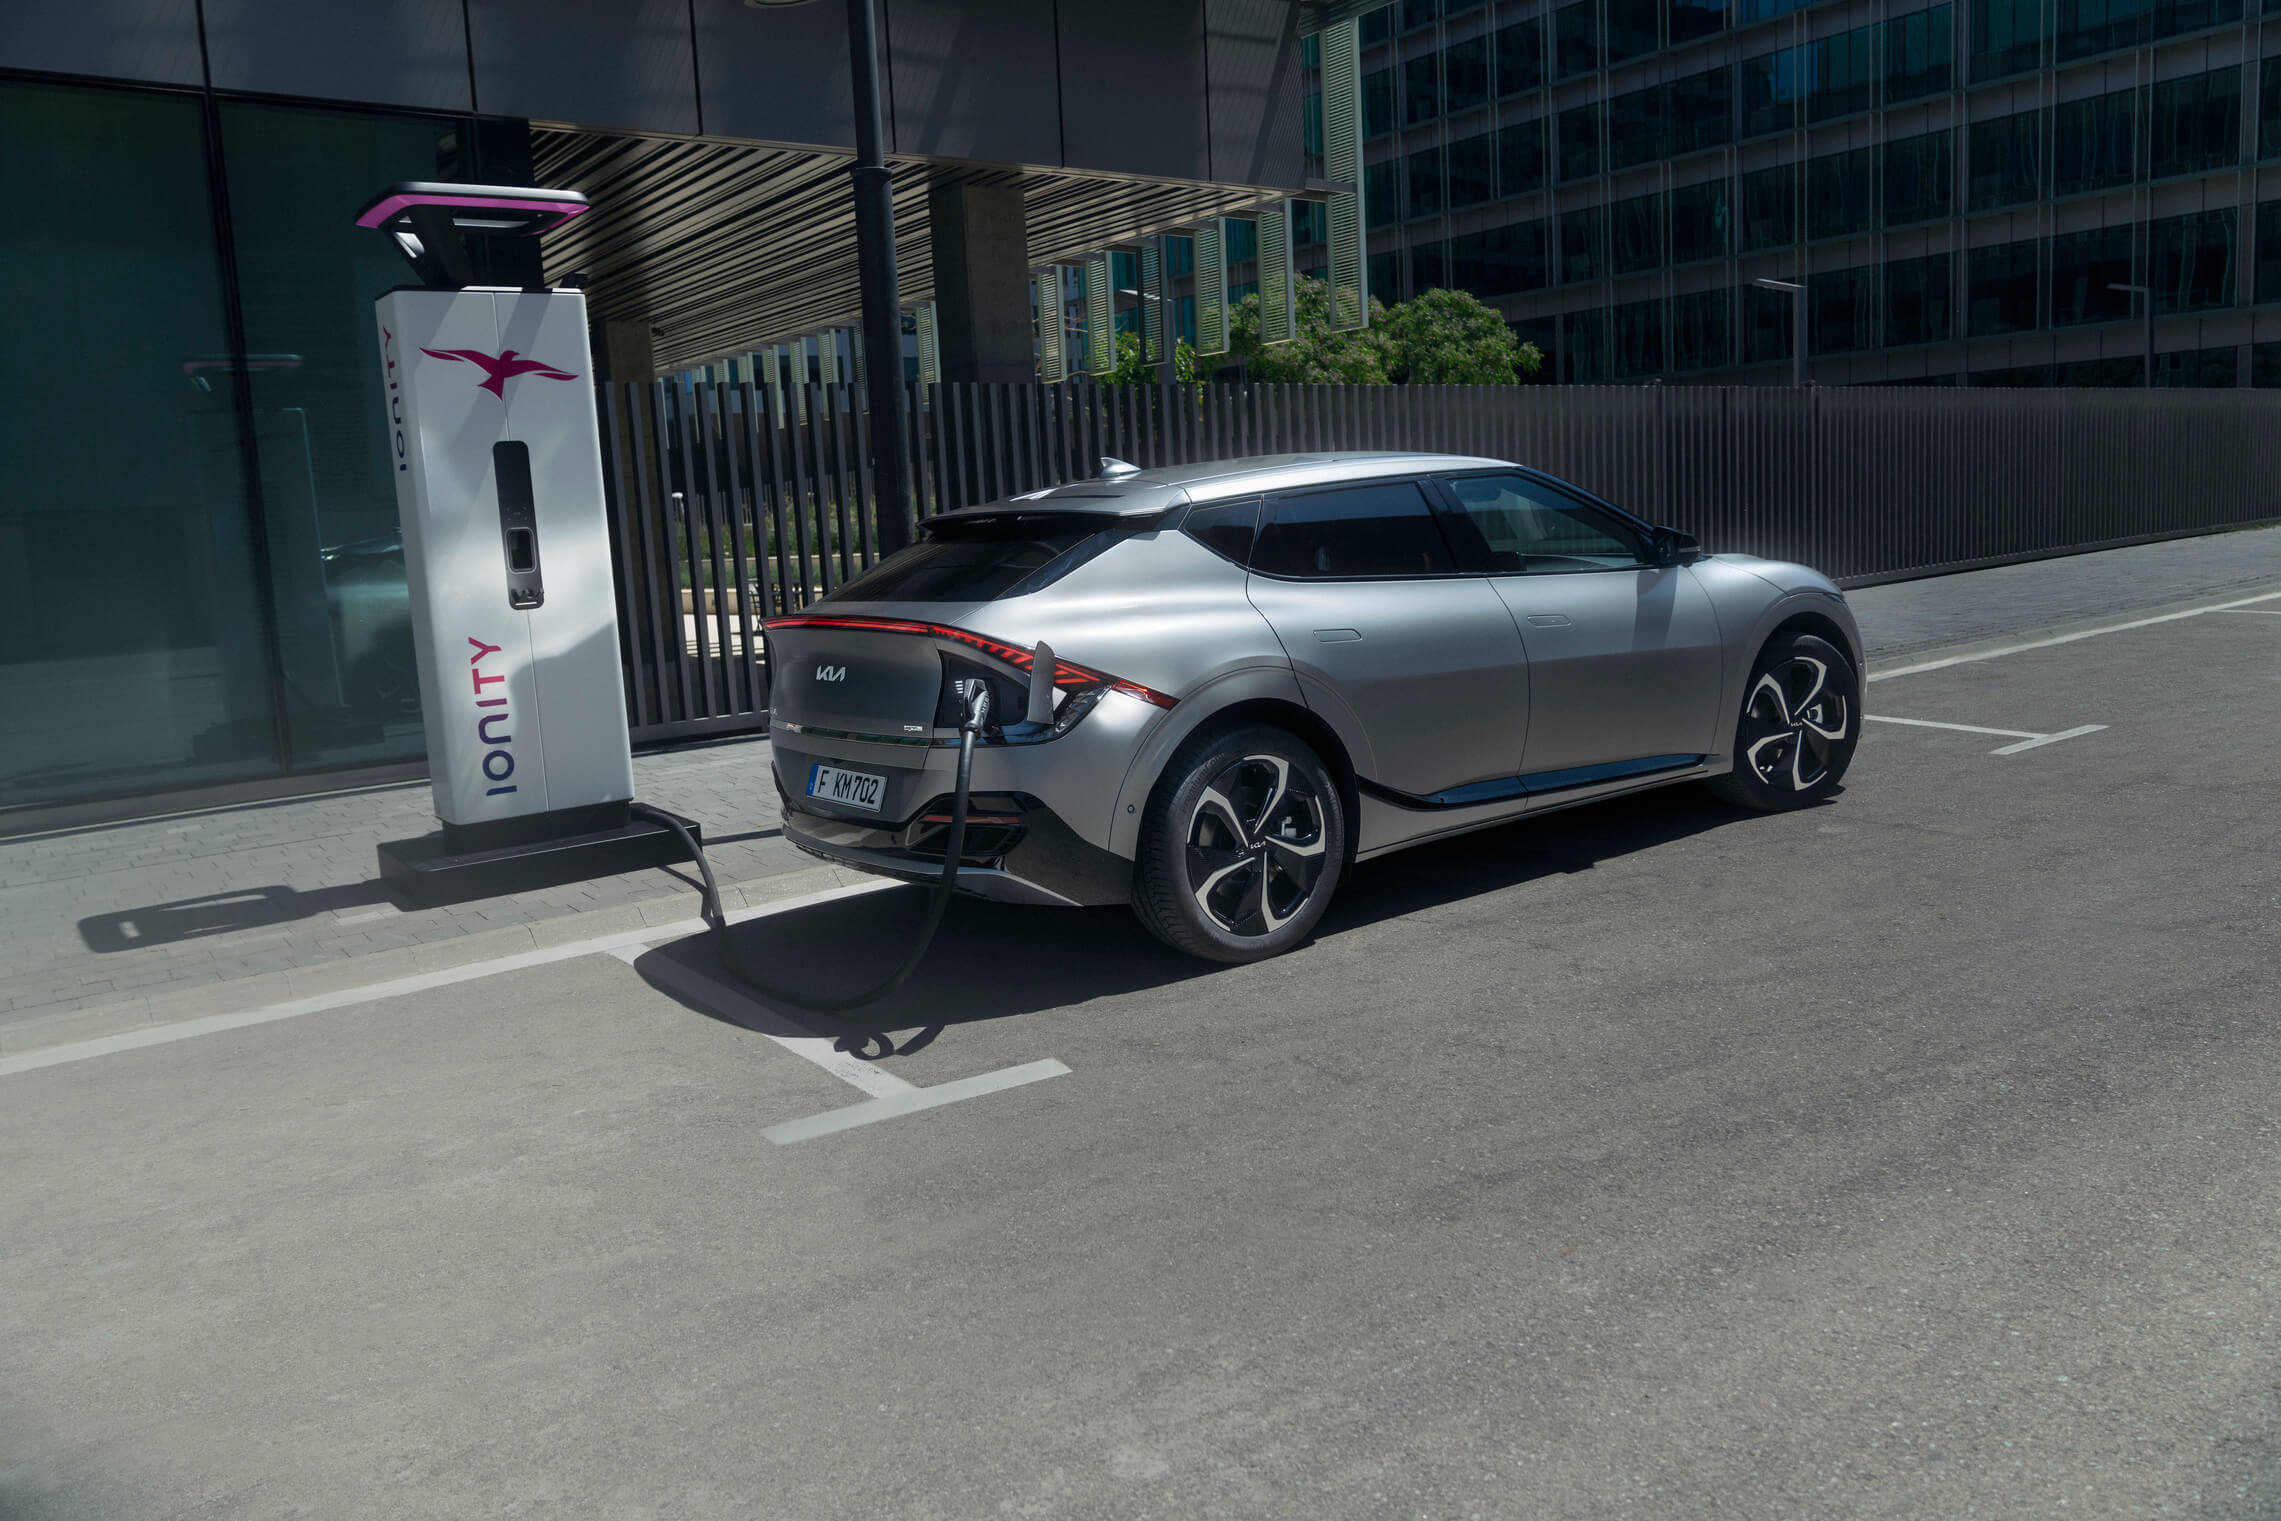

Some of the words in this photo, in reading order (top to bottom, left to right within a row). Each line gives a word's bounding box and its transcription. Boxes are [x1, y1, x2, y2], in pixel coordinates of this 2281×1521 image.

[816, 665, 847, 682] KIA
[468, 637, 517, 796] IONITY
[817, 770, 829, 793] F
